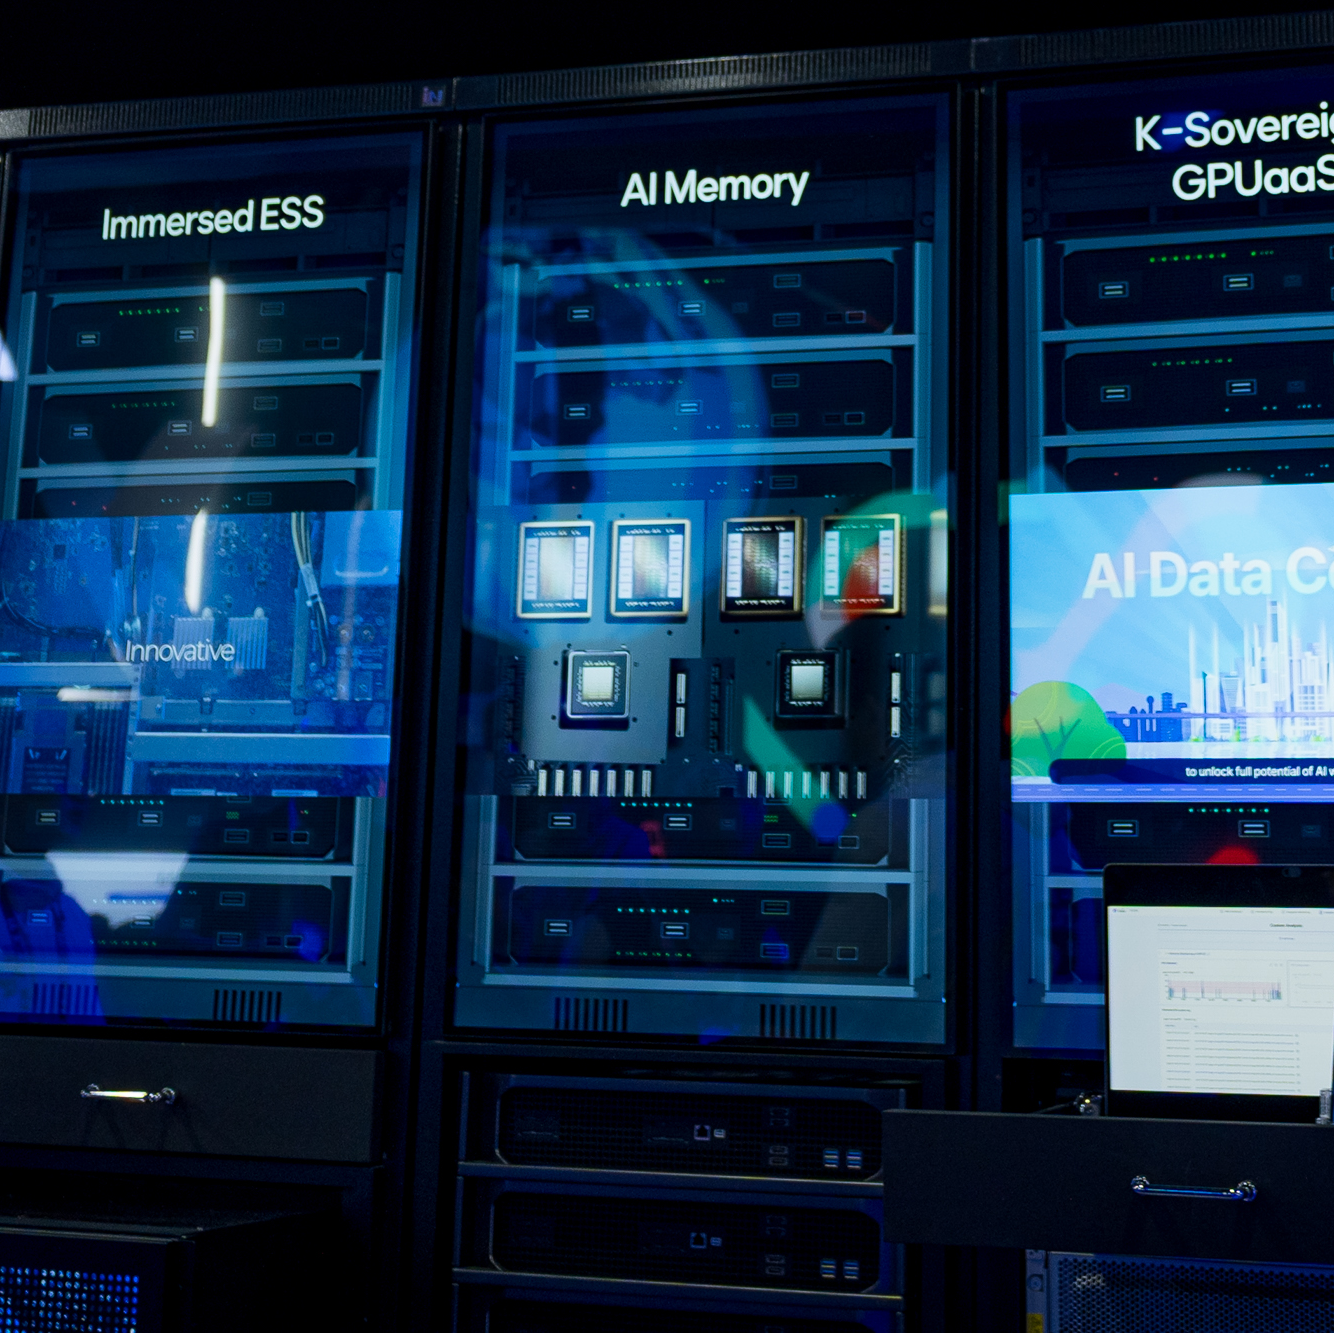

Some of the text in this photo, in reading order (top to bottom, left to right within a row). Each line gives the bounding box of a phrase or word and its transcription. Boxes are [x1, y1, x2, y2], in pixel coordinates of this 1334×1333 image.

[620, 169, 810, 207] AI Memory
[102, 194, 325, 240] Immersed ESS
[1081, 552, 1136, 599] AI
[1150, 551, 1273, 599] Data
[125, 638, 235, 662] Innovative
[1185, 767, 1197, 777] to
[1198, 766, 1234, 777] unlock
[1235, 766, 1252, 777] full
[1253, 765, 1301, 779] potential
[1302, 765, 1313, 777] of
[1315, 766, 1327, 776] AI
